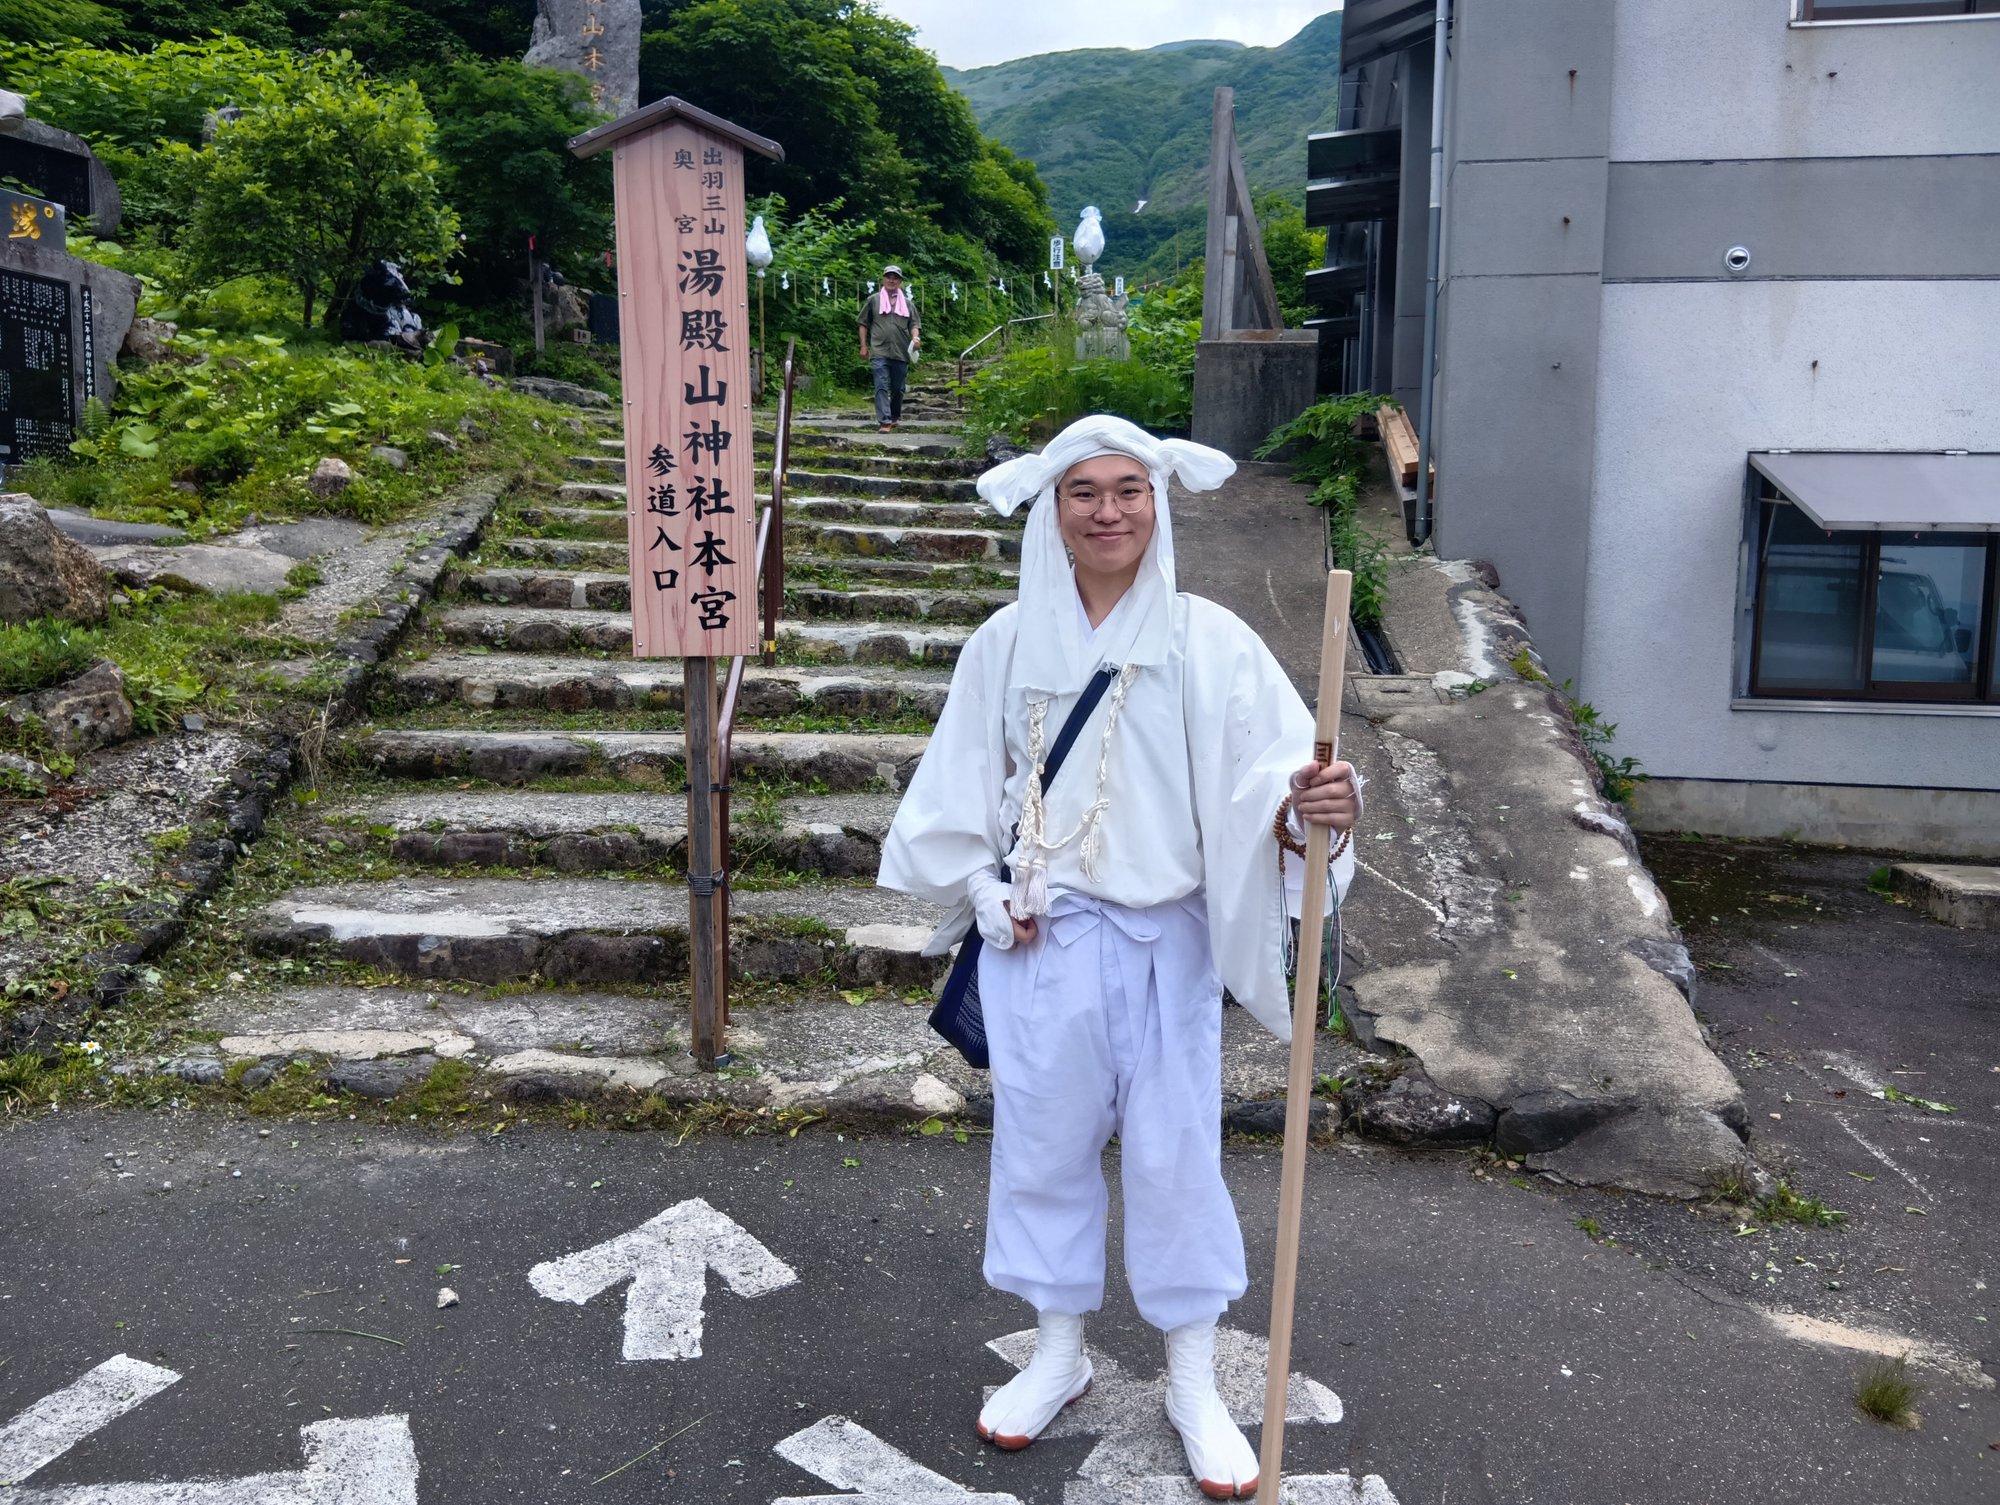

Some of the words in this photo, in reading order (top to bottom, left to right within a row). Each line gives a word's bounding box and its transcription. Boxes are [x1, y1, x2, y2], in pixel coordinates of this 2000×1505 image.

[582, 0, 606, 105] 山本宮
[673, 148, 697, 234] 奥宮
[701, 147, 726, 236] 出羽三山
[677, 248, 736, 631] 湯殿山神社本宮
[646, 443, 683, 592] 参道入口
